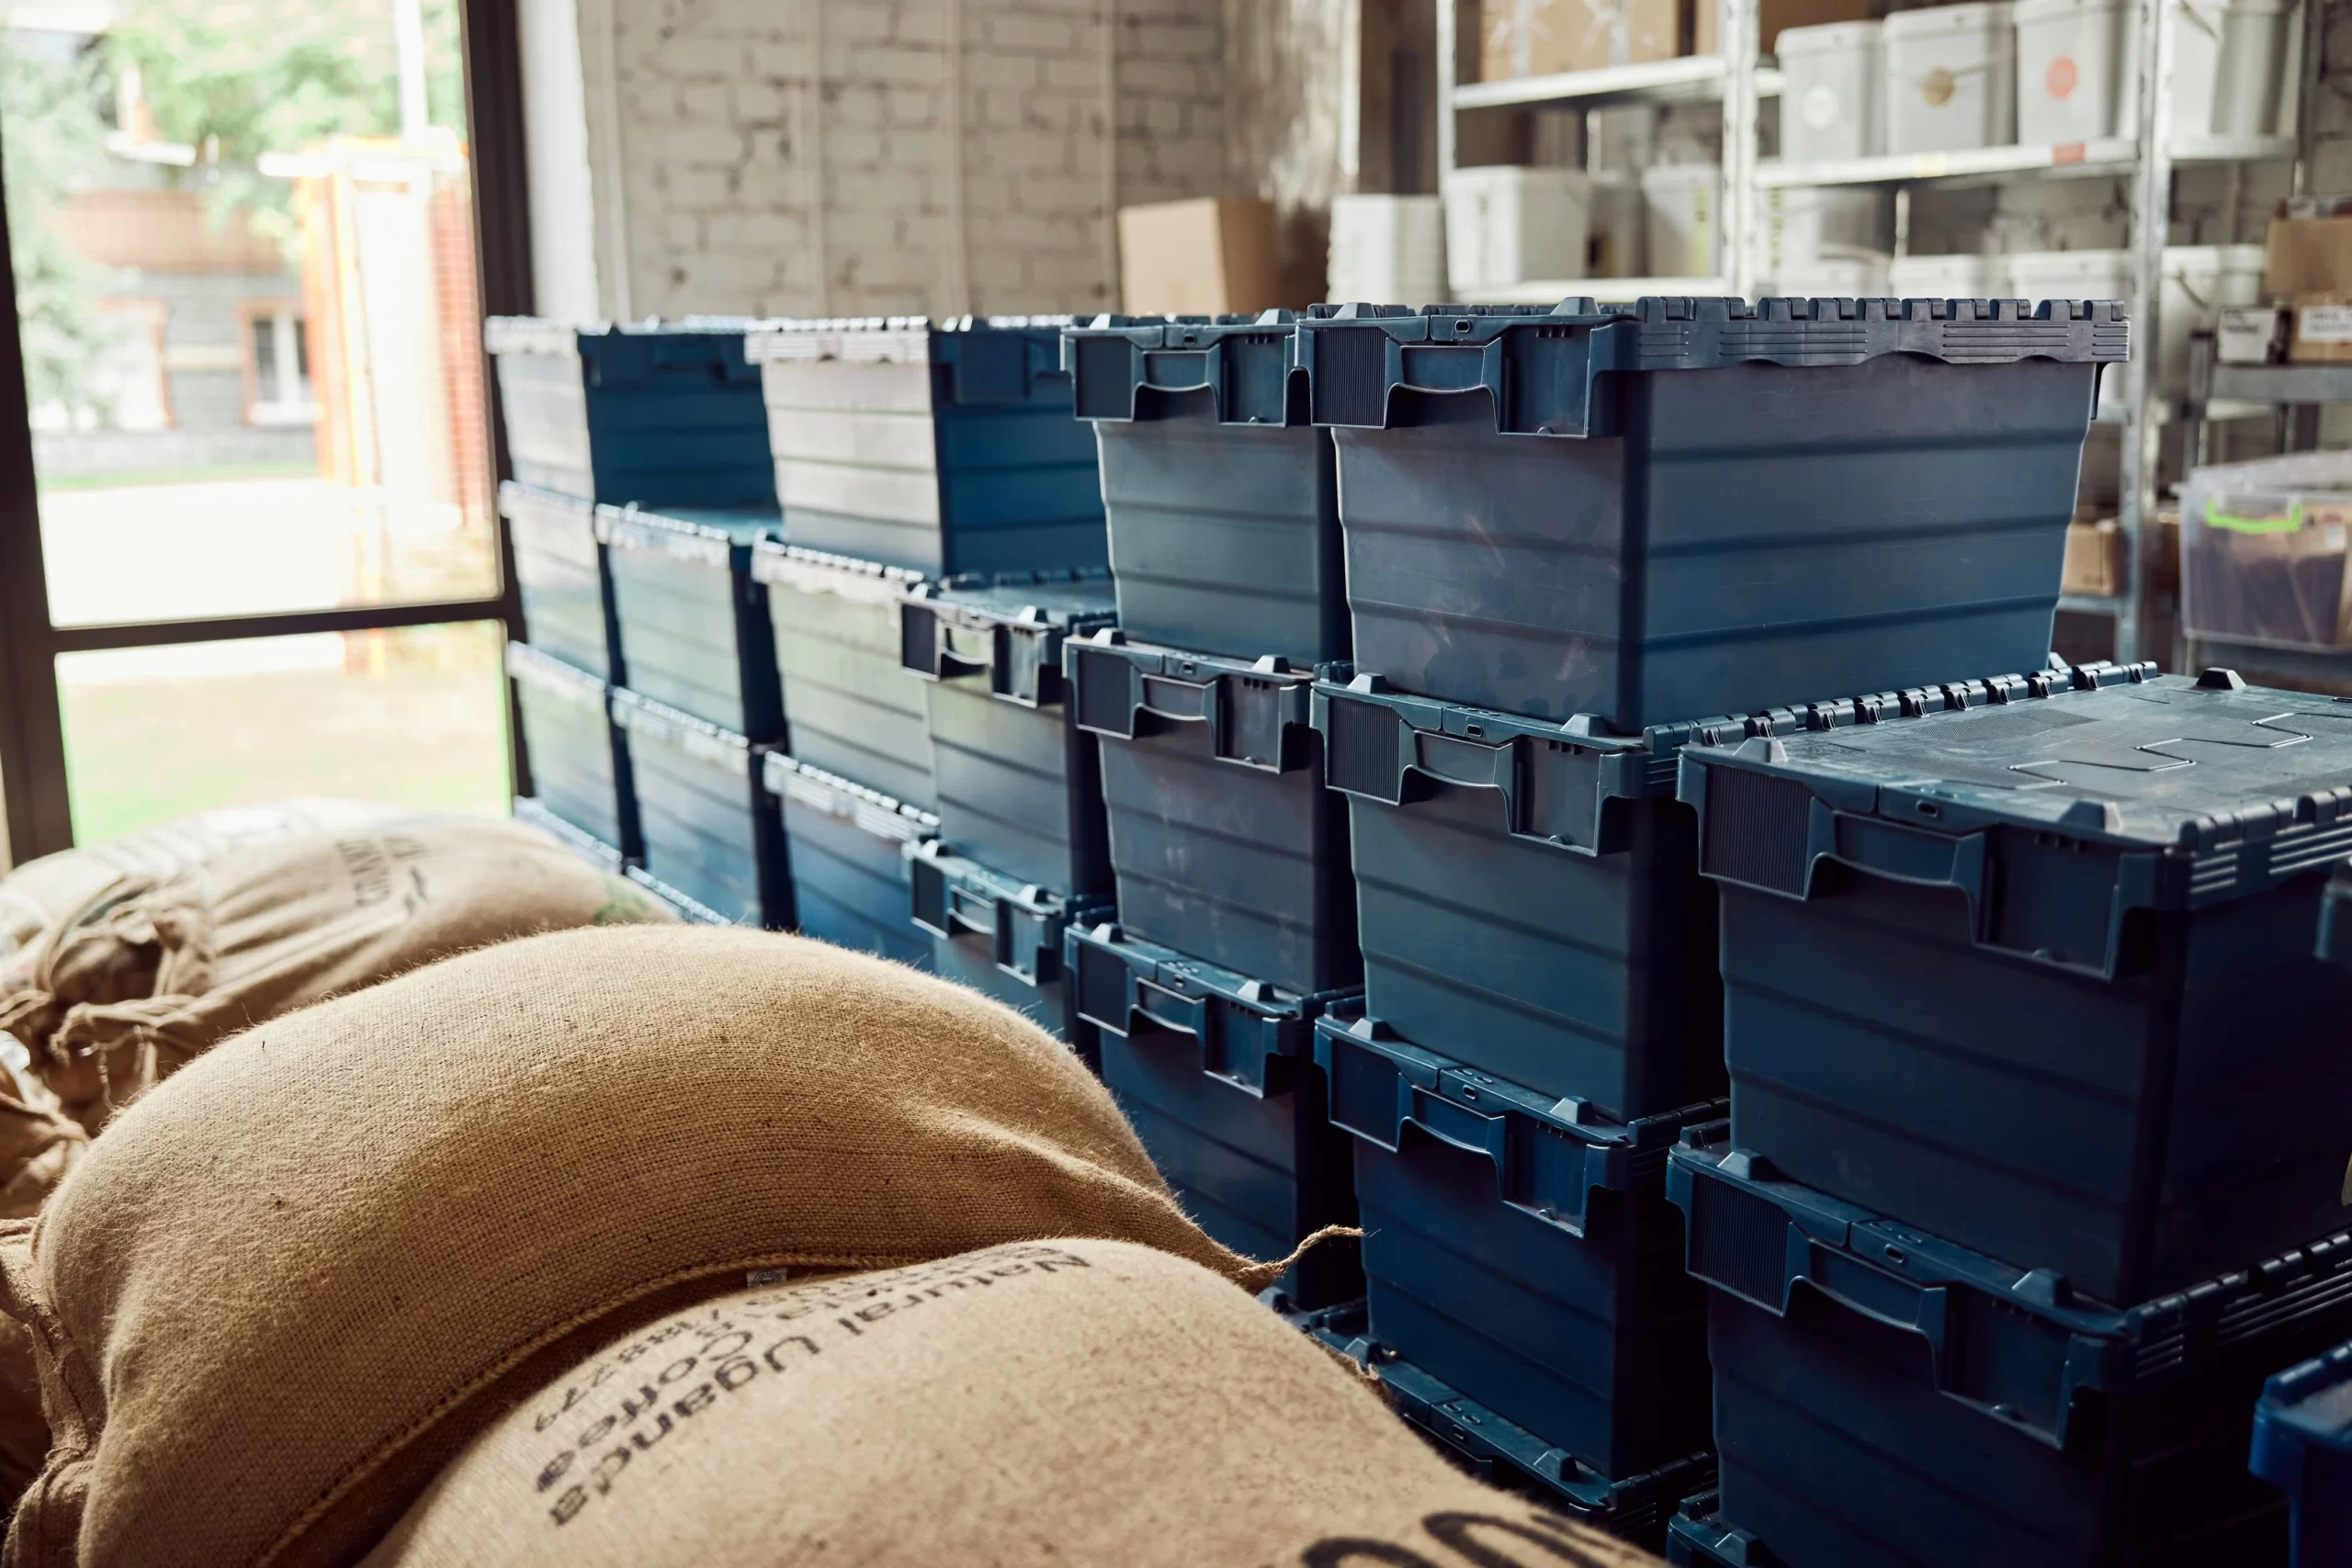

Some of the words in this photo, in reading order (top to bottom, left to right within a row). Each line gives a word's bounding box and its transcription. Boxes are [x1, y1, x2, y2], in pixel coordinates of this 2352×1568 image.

[839, 1255, 1091, 1335] Natural
[537, 1331, 752, 1492] Coffee
[549, 1336, 820, 1526] Uganda
